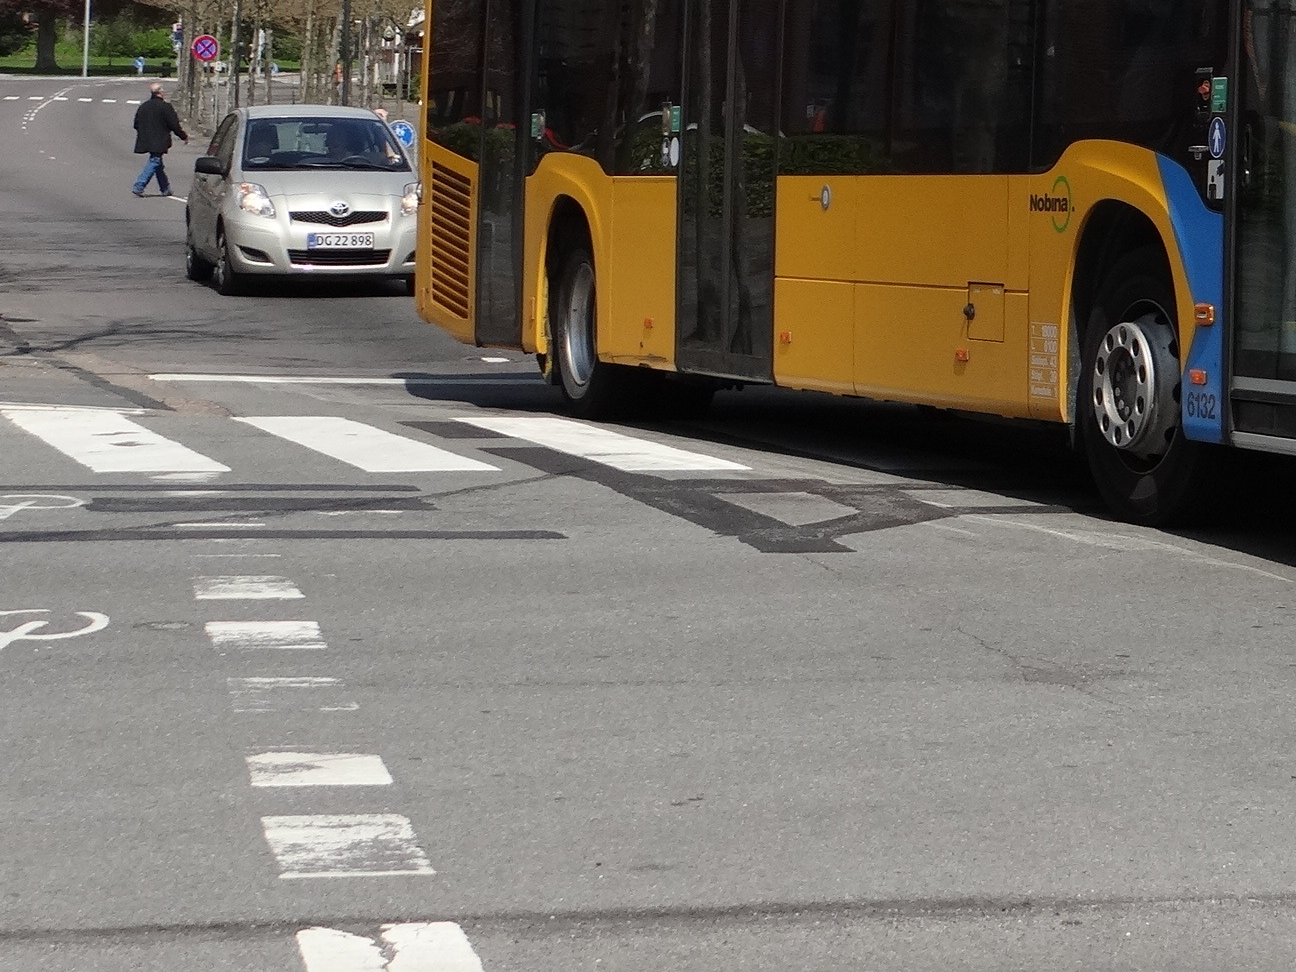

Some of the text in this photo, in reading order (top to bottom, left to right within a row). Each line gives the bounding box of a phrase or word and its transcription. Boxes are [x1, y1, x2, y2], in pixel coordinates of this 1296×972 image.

[316, 235, 332, 246] DG
[334, 235, 349, 246] 22
[351, 235, 372, 246] 898
[1187, 391, 1216, 419] 6132
